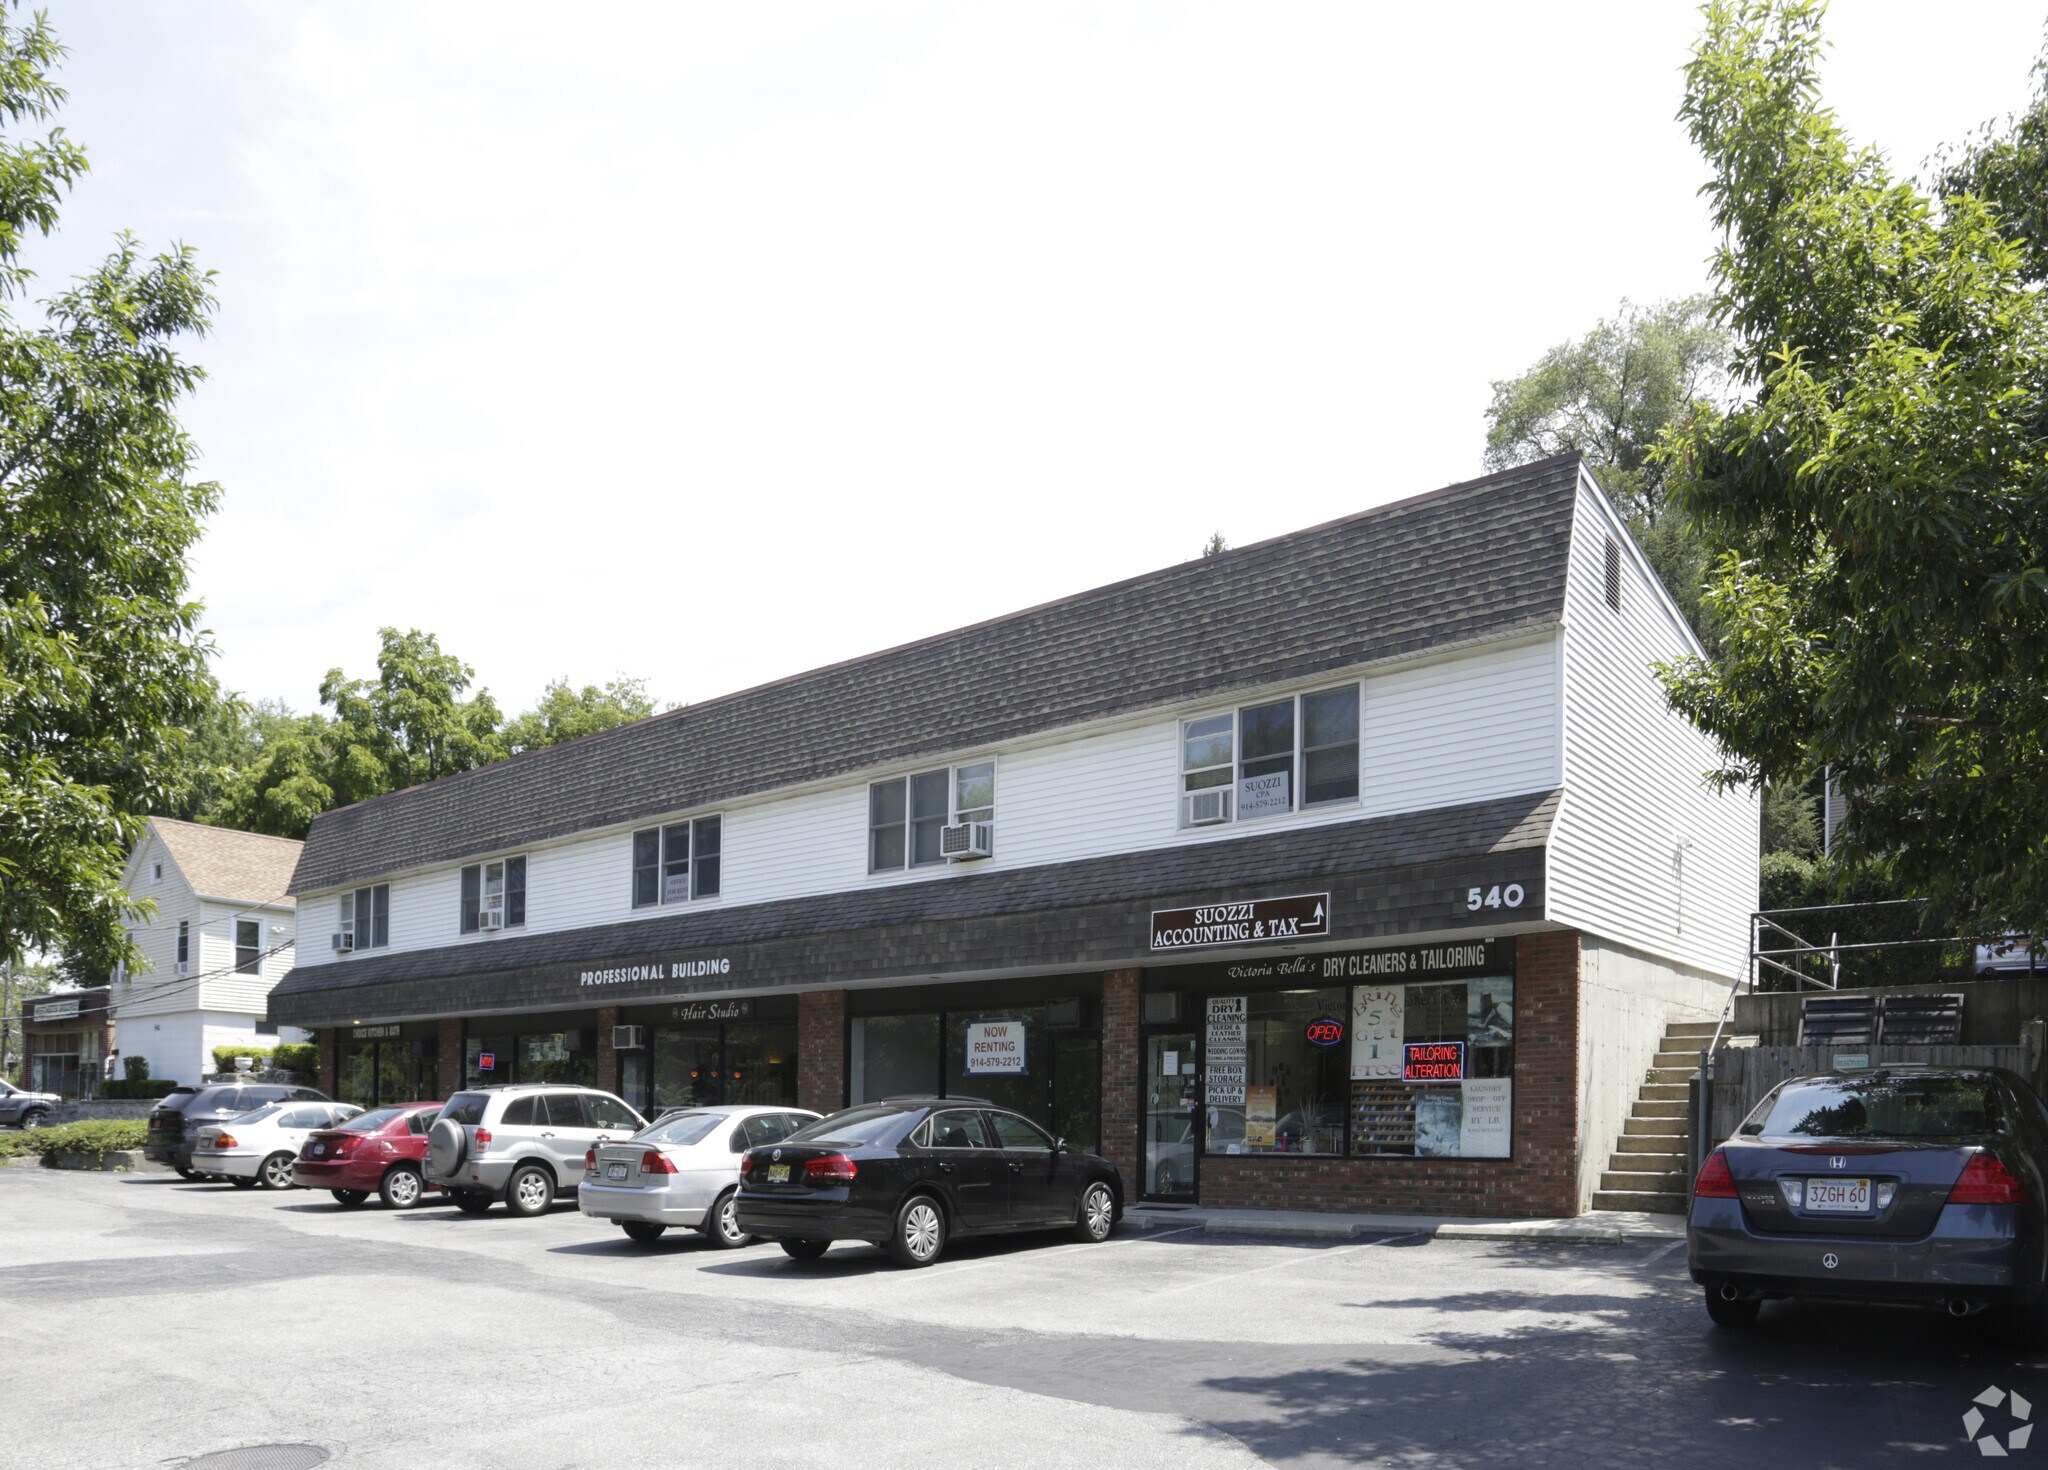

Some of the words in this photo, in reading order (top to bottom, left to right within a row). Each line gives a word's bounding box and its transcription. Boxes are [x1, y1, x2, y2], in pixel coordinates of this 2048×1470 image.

[1245, 777, 1281, 792] SUOZZI
[1255, 790, 1270, 799] CPA
[1240, 797, 1286, 811] 914-579-2212
[1467, 883, 1525, 911] 540
[1194, 904, 1255, 924] SUOZZI
[1154, 922, 1250, 947] ACCOUNTING
[1253, 921, 1265, 937] &
[1269, 917, 1299, 935] TAX
[1228, 963, 1272, 978] Victoria
[1277, 957, 1316, 975] Bella's
[1323, 957, 1346, 977] DRY
[1349, 952, 1407, 976] CLEANERS
[1409, 954, 1417, 970] &
[1420, 945, 1485, 970] TAILORING
[581, 964, 664, 986] PROFESSIONAL
[672, 958, 730, 978] BUILDING
[681, 1003, 706, 1020] Hair
[708, 1002, 739, 1020] Studio
[1212, 1005, 1235, 1013] DRY
[1207, 1013, 1246, 1023] CLEANING
[1368, 1010, 1382, 1026] 5
[984, 1026, 1007, 1037] NOW
[1306, 1025, 1344, 1040] OPEN
[974, 1041, 1015, 1053] RENTING
[1368, 1043, 1380, 1060] 1
[1409, 1046, 1457, 1061] TAILORING
[970, 1056, 1021, 1067] 914-579-2212
[1210, 1066, 1225, 1074] FREE
[1227, 1066, 1242, 1074] BOX
[1405, 1063, 1460, 1078] ALTERATION
[1209, 1075, 1242, 1084] STORAGE
[1208, 1087, 1225, 1095] PICK
[1226, 1087, 1236, 1095] UP
[1237, 1087, 1243, 1095] &
[1209, 1095, 1242, 1104] DELIVERY
[1472, 1105, 1501, 1113] SERVICE
[1471, 1116, 1482, 1125] BY
[1810, 1187, 1845, 1202] 3ZGH
[1849, 1187, 1867, 1203] 60
